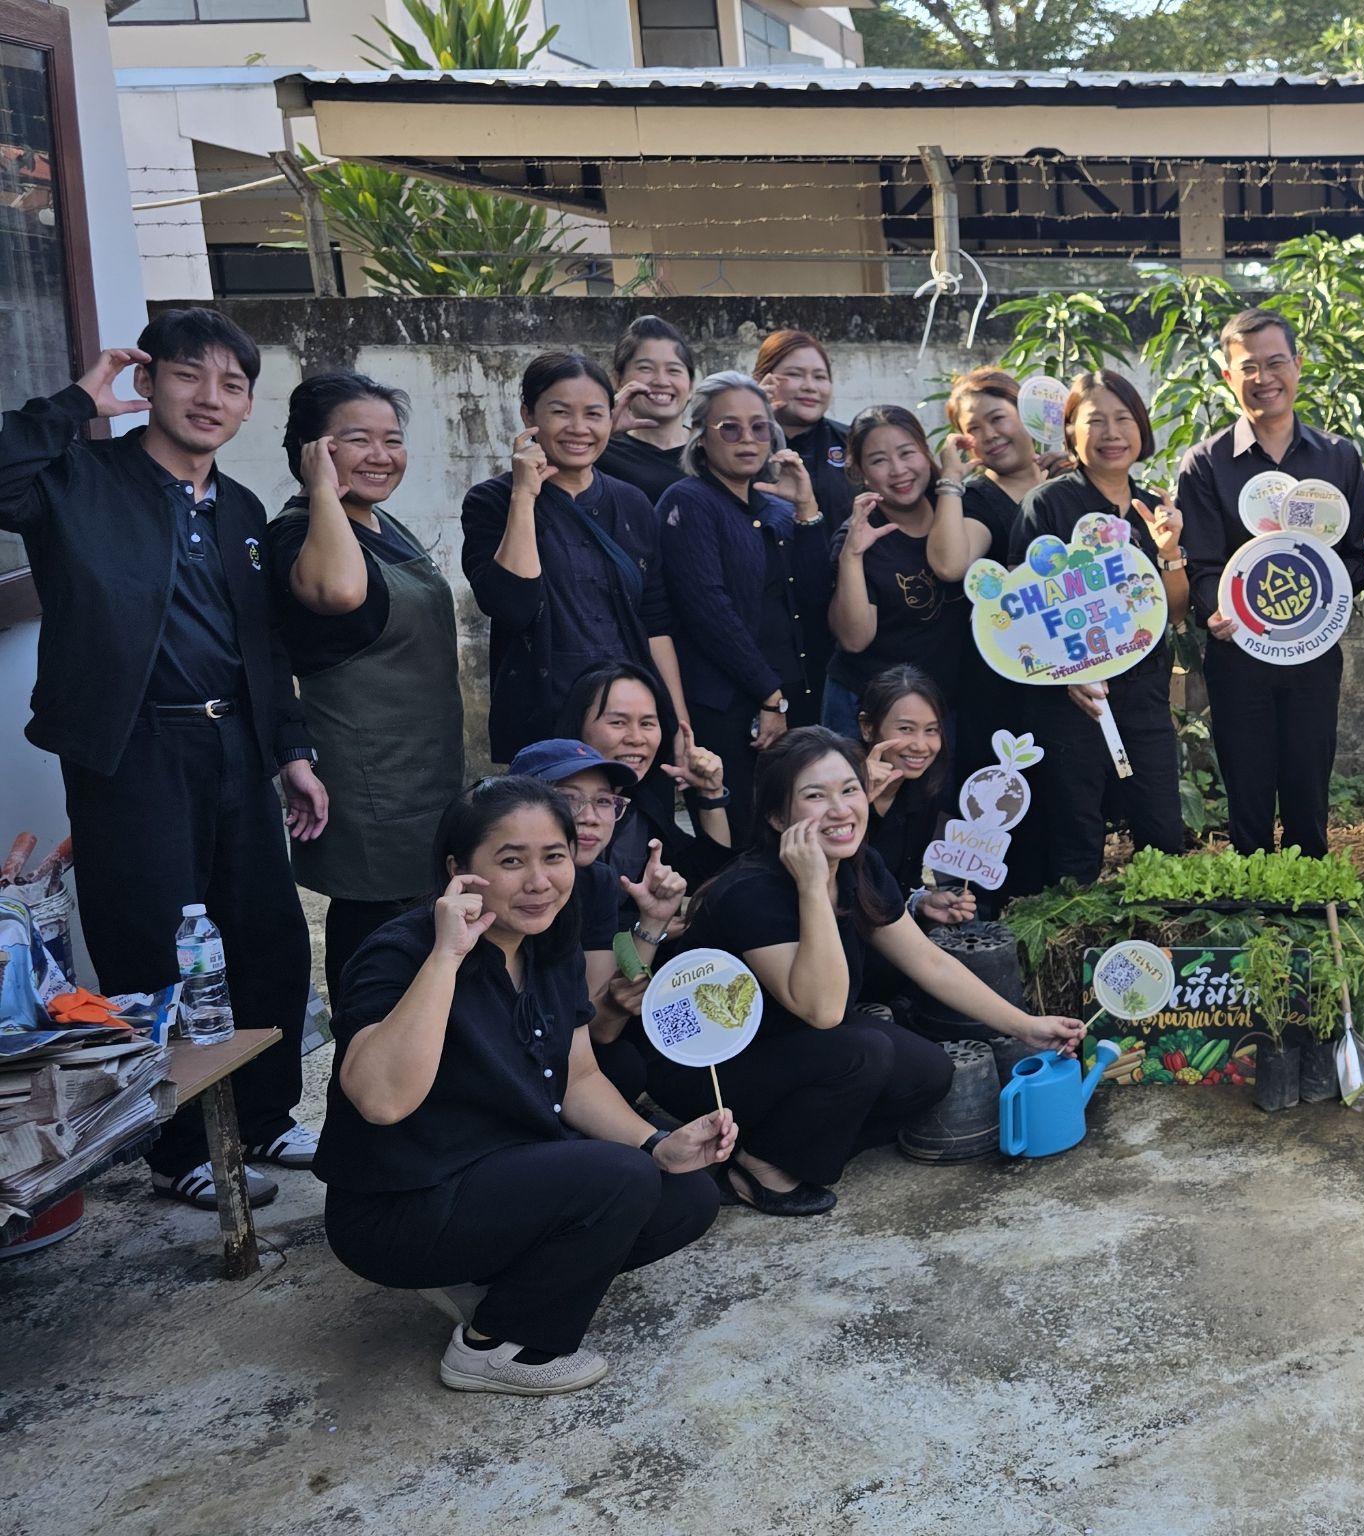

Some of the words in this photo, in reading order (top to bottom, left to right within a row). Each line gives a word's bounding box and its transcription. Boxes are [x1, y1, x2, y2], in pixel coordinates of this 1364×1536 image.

[1000, 553, 1126, 620] CHANGE
[1244, 594, 1349, 658] กรมการพัฒนาชุมชน
[951, 824, 1003, 857] World
[929, 843, 966, 868] Soil
[966, 854, 1002, 885] Day
[672, 962, 714, 988] ผักเคล
[1130, 949, 1163, 981] กะเพรา
